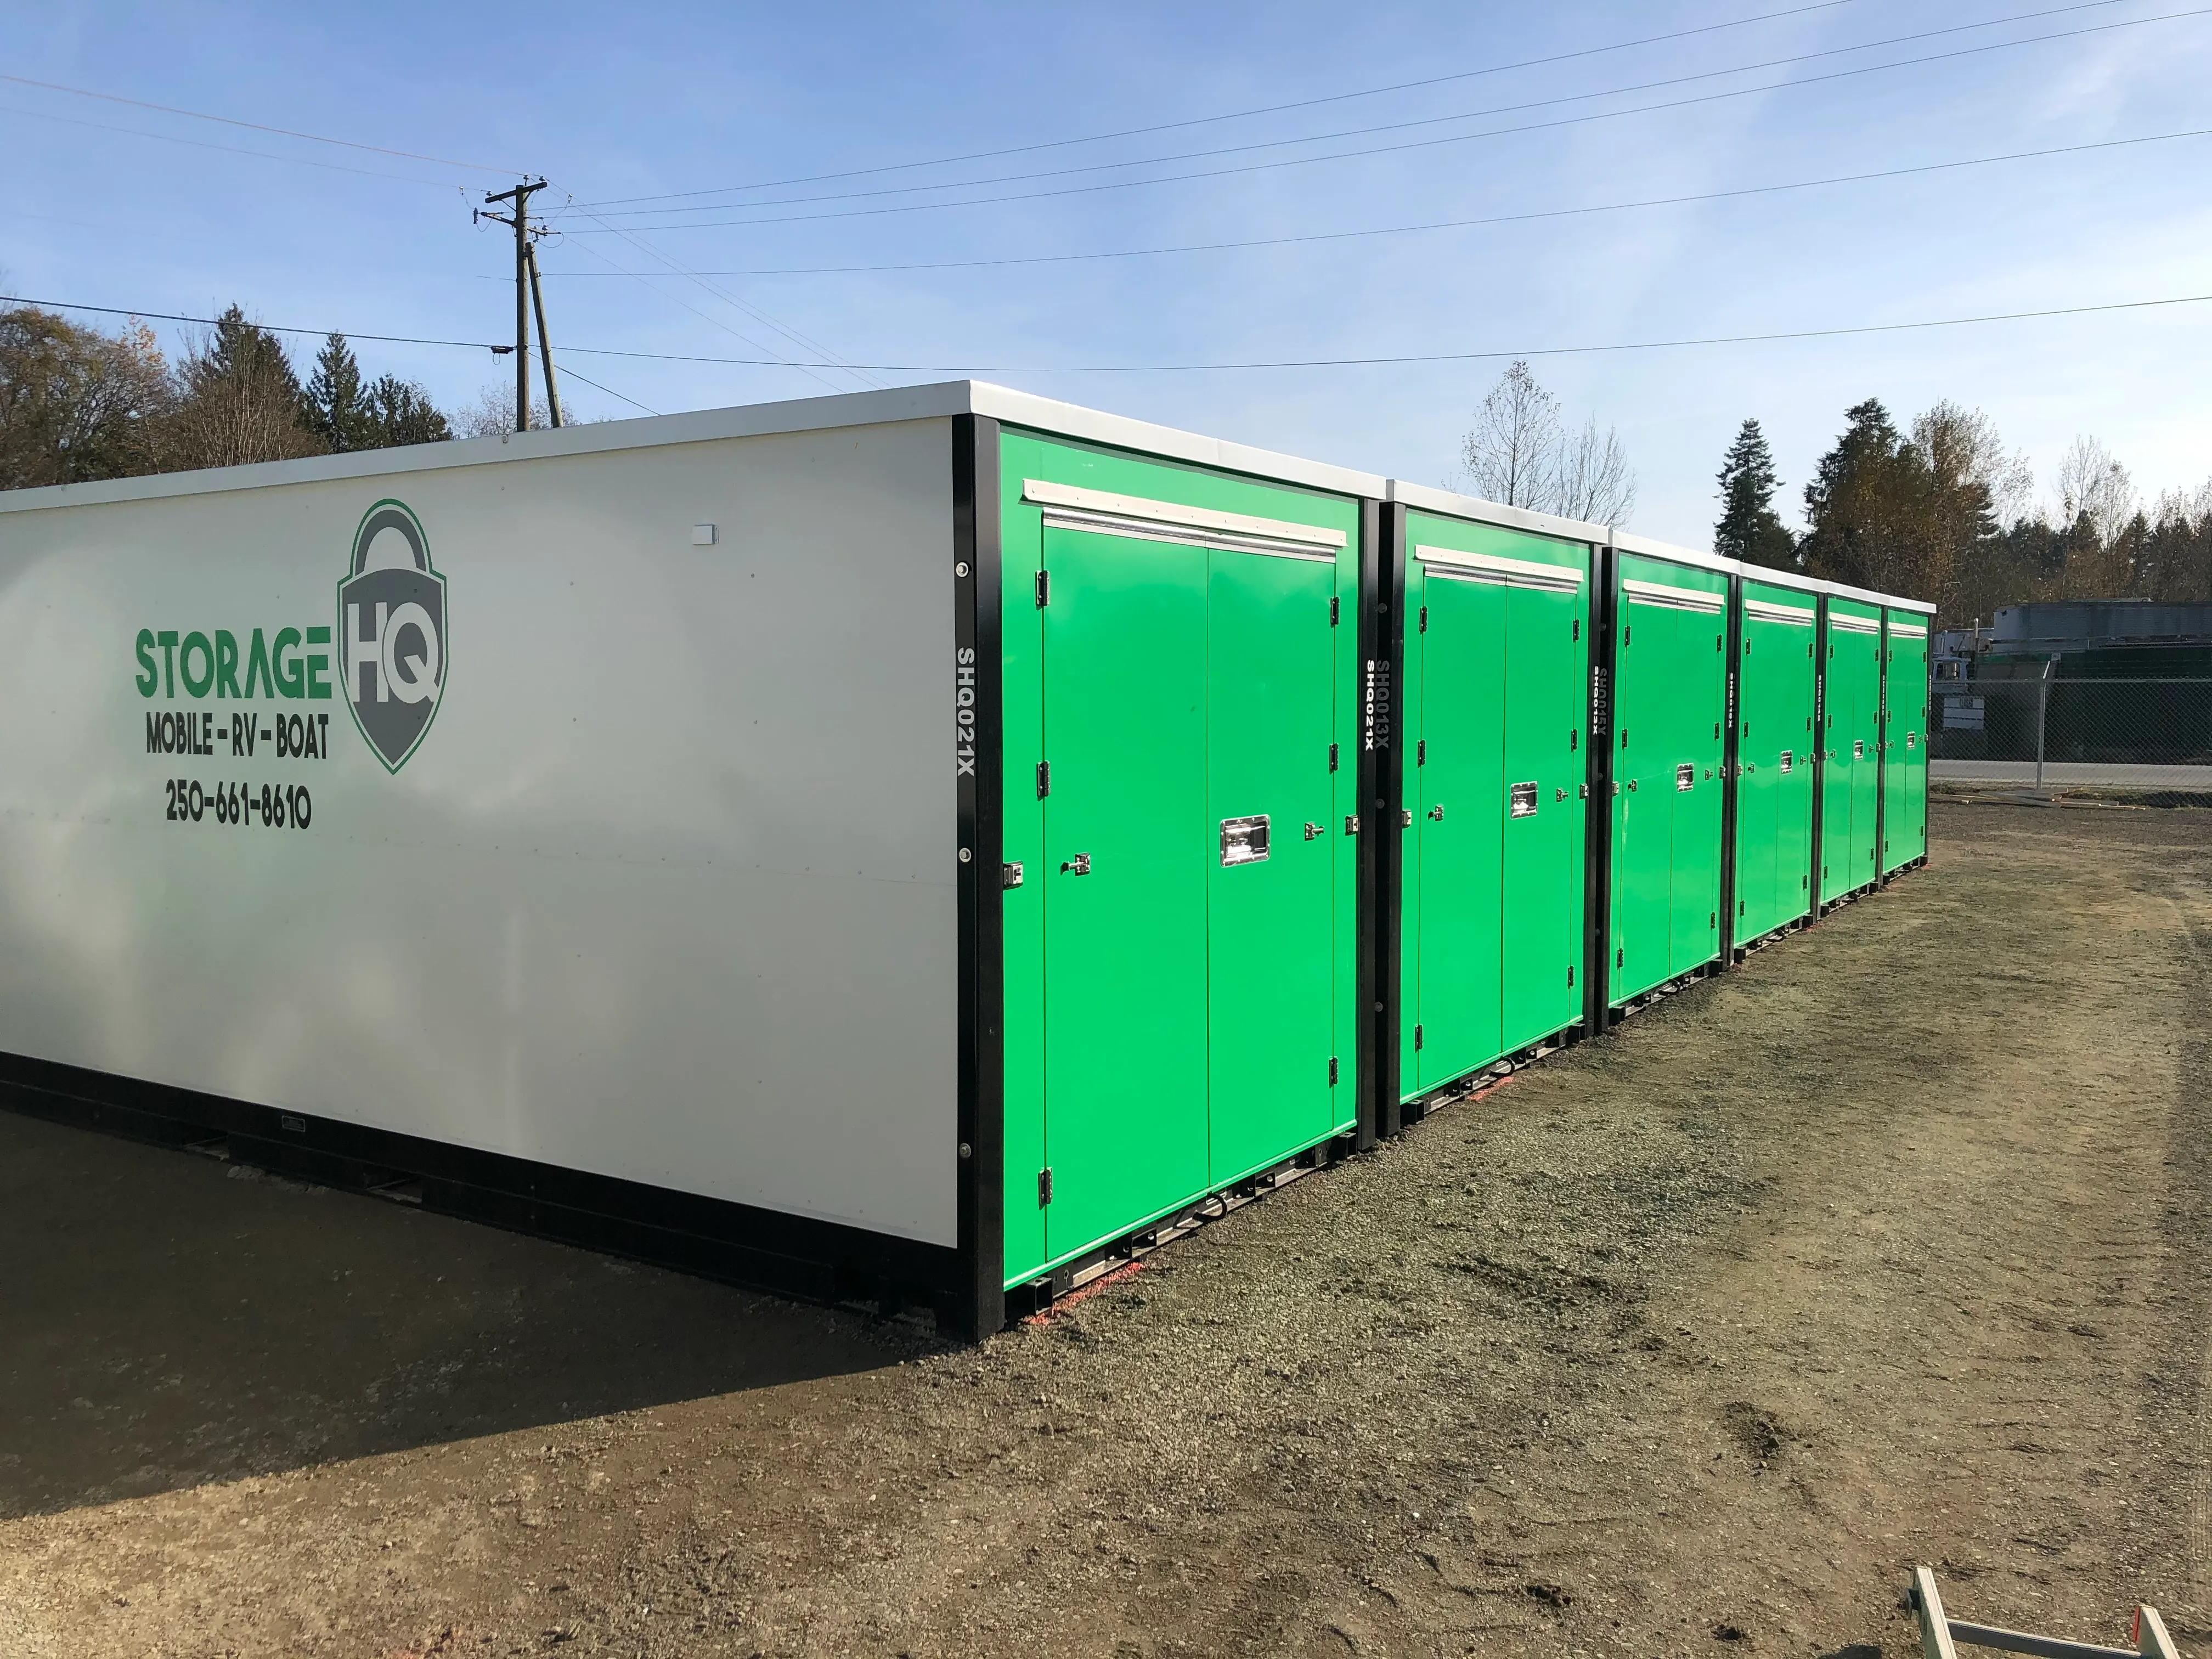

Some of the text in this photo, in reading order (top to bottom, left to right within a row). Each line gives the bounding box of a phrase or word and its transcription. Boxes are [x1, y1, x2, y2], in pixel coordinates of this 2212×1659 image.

[136, 602, 439, 704] STORAGE HQ
[957, 647, 975, 776] SHQ021X
[1365, 659, 1375, 751] SHQ021X
[1375, 660, 1390, 748] SHQ013X
[166, 778, 312, 830] 250-661-8610
